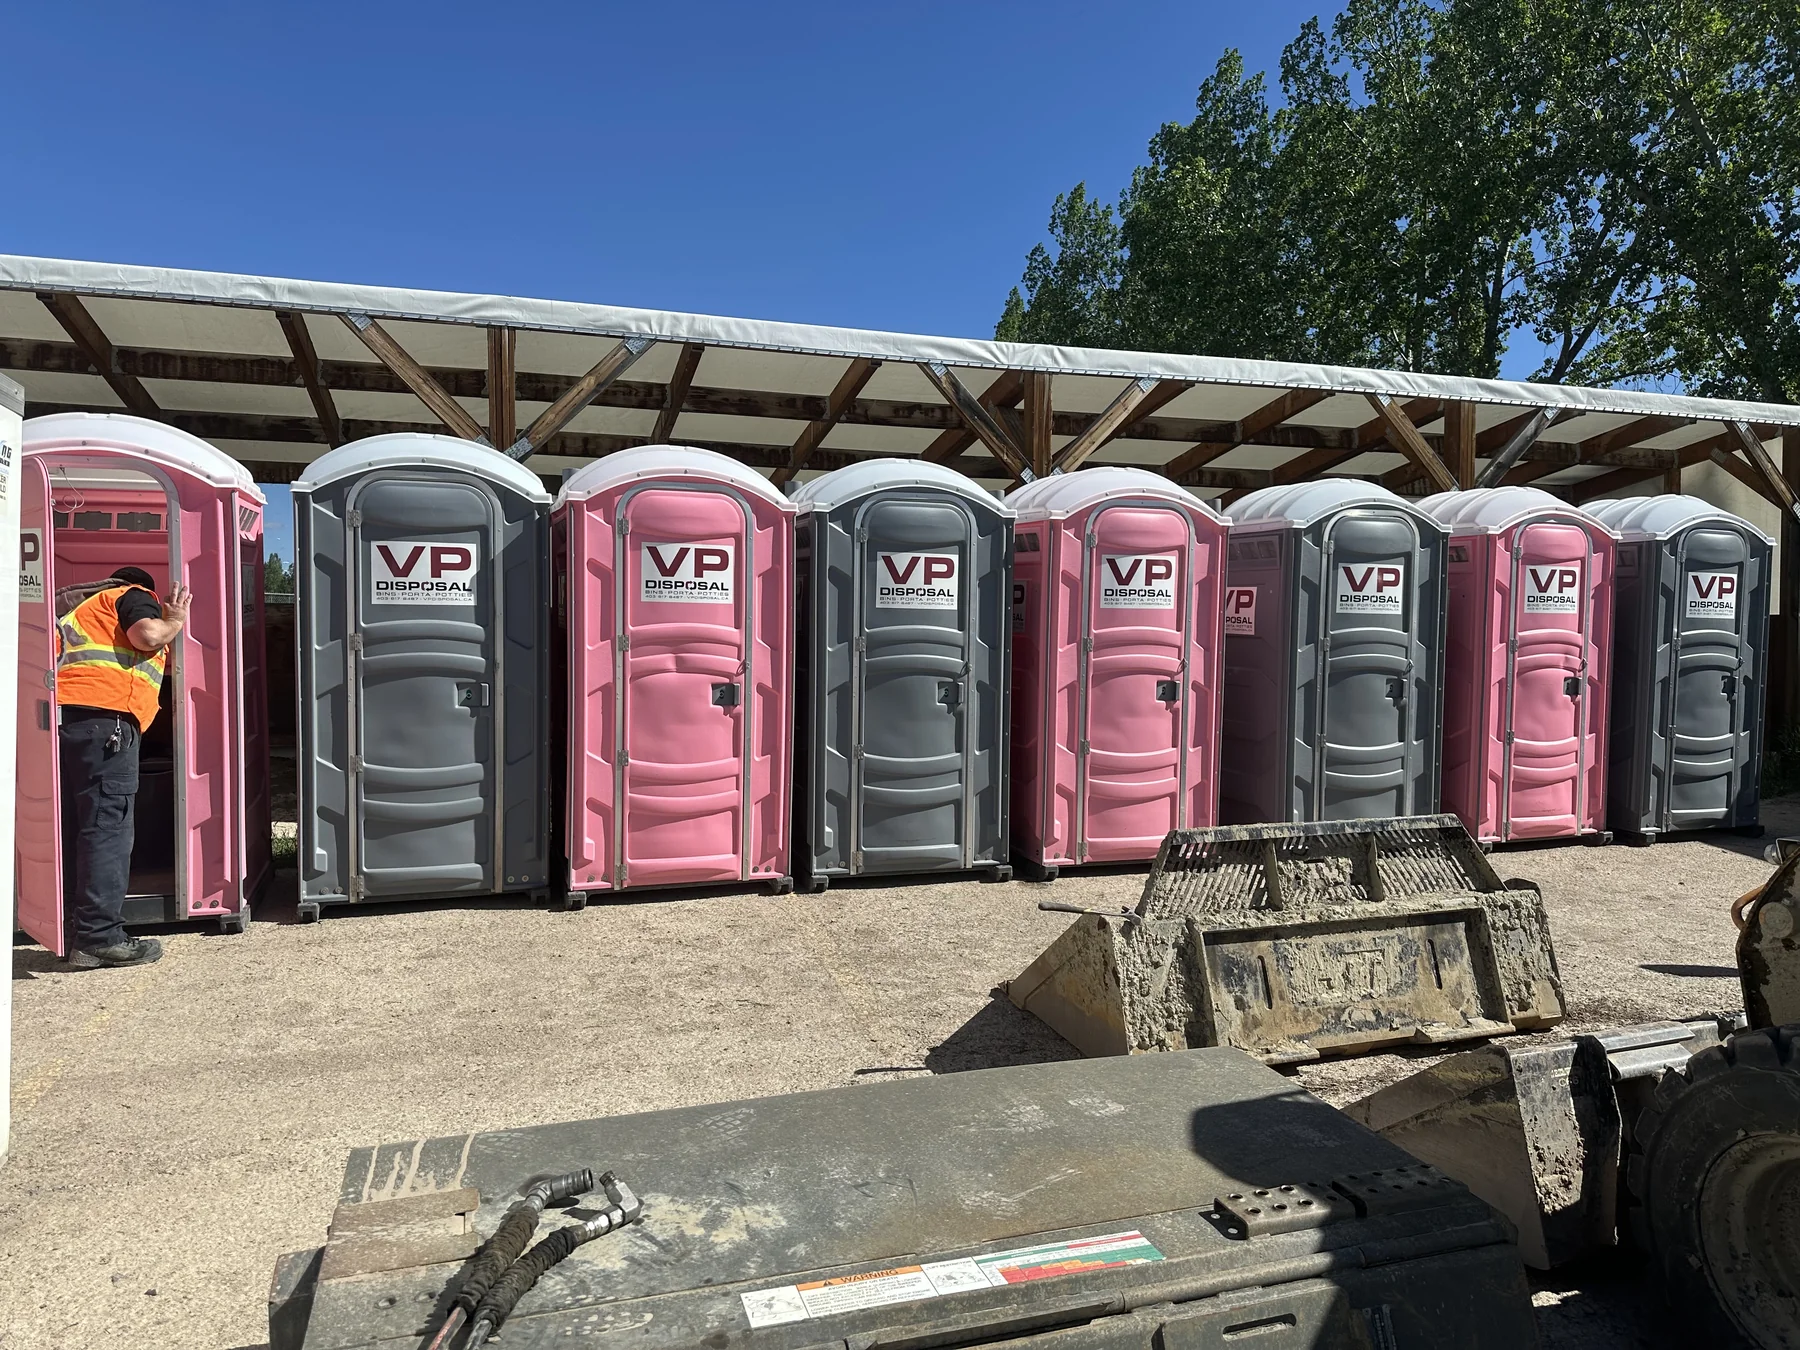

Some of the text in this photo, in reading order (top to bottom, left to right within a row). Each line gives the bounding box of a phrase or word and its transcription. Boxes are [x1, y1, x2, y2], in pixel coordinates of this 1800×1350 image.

[376, 545, 472, 578] VP
[646, 546, 729, 578] VP
[881, 556, 954, 585] VP
[1106, 558, 1172, 586] VP
[1342, 567, 1400, 592] VP
[1529, 569, 1576, 593] VP
[376, 581, 472, 591] DISPOSAL
[645, 580, 728, 590] DISPOSAL
[880, 587, 954, 597] DISPOSAL
[1104, 589, 1171, 597] DISPOSAL
[1692, 576, 1735, 599] VP
[1340, 595, 1399, 603] DISPOSAL
[1690, 601, 1733, 609] DISPOSAL
[840, 1269, 898, 1282] WARNING
